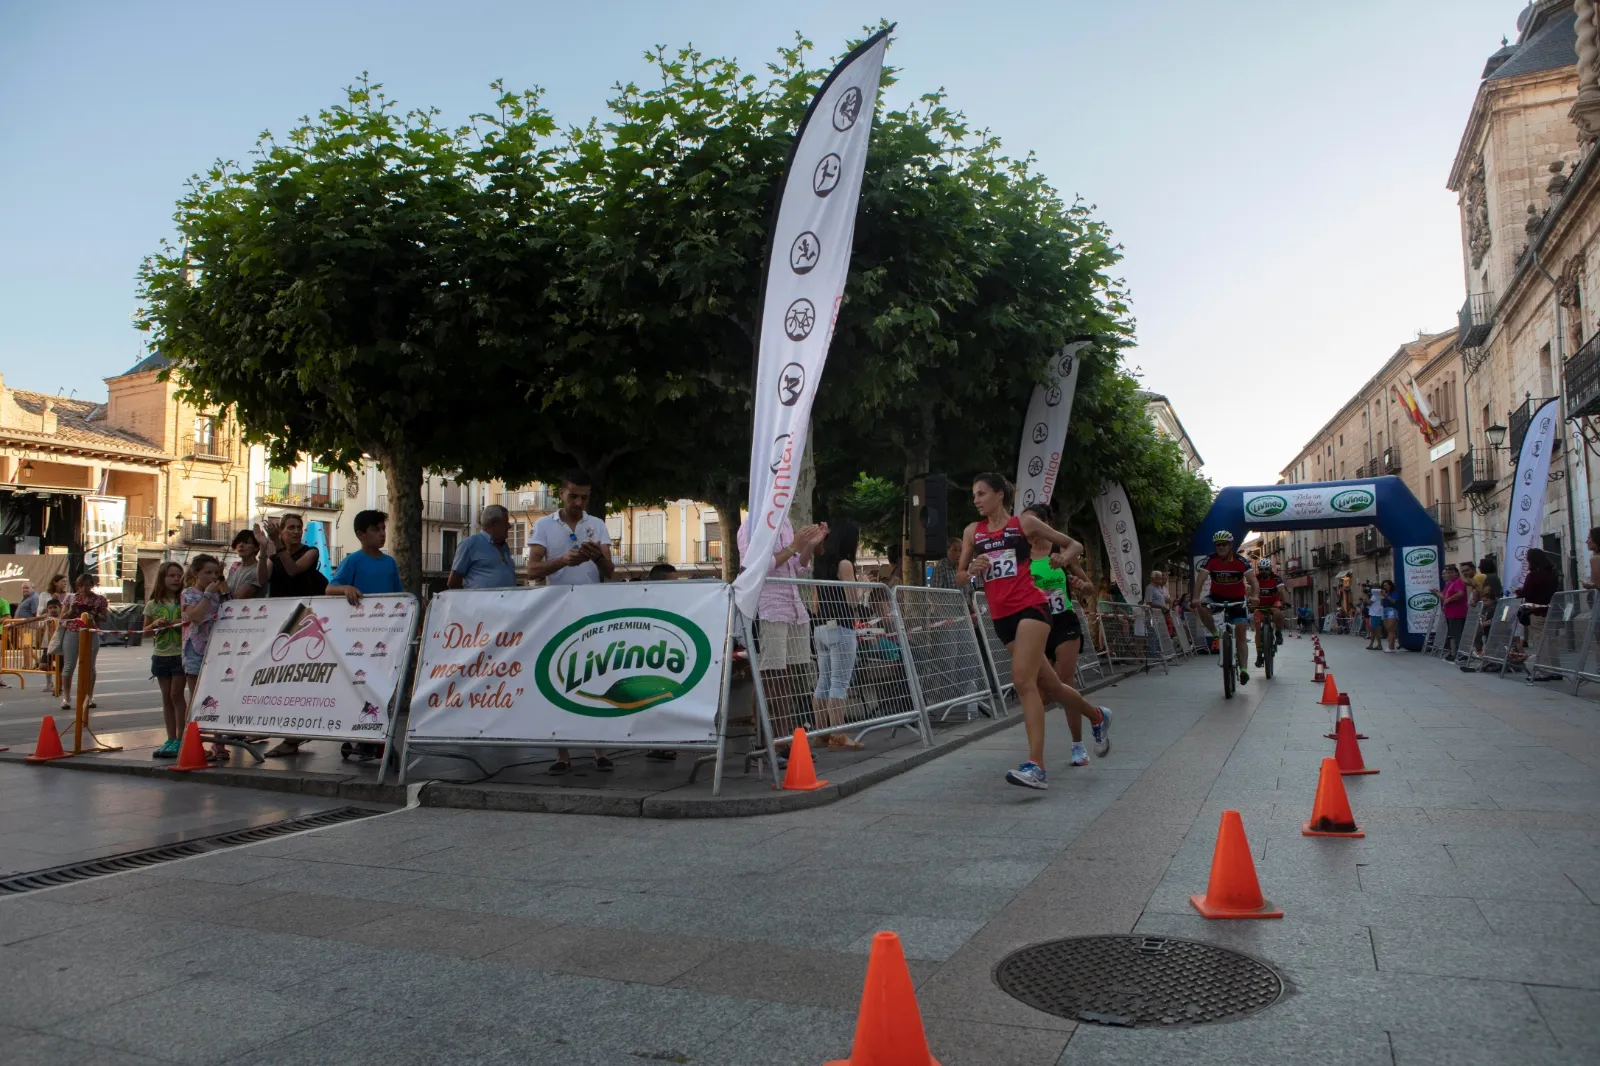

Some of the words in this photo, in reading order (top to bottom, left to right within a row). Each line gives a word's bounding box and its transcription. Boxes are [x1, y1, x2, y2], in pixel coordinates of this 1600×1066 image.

[1040, 452, 1060, 504] Contigo
[986, 560, 1015, 580] 252
[495, 631, 524, 648] un
[581, 625, 605, 642] PURE
[607, 621, 651, 633] PREMIUM
[250, 662, 338, 687] RUNVASPORT
[429, 651, 523, 679] mordisco
[241, 695, 282, 706] SERVICIOS
[283, 696, 336, 708] DEPORTIVOS
[428, 692, 443, 708] a
[444, 681, 464, 708] la
[228, 714, 342, 731] www.runvasport.es
